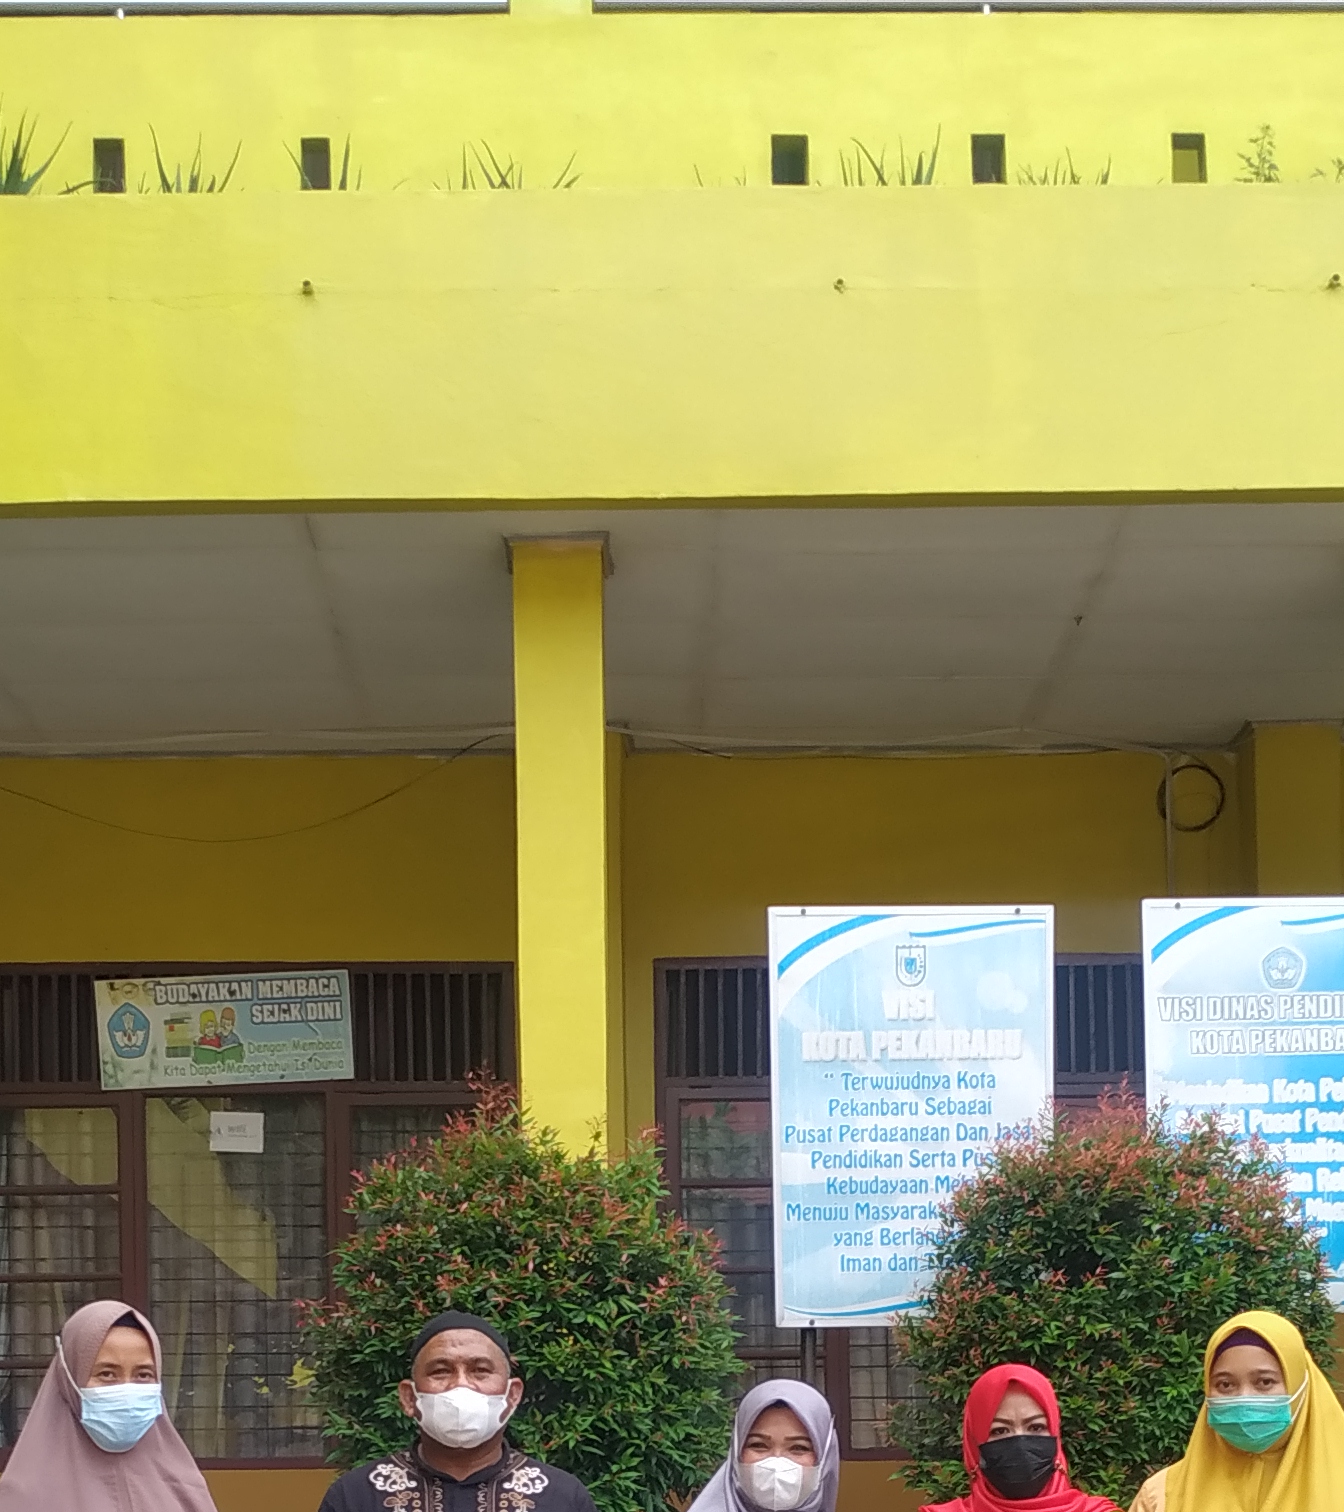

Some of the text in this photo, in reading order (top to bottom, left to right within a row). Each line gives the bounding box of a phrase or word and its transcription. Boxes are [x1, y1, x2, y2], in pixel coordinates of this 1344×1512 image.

[154, 980, 253, 1005] BUDAYAKAN
[256, 976, 341, 1000] MEMBACA
[250, 999, 343, 1025] SEJAK DINI
[881, 989, 935, 1022] VISI
[1157, 995, 1204, 1022] VISI
[1208, 994, 1275, 1021] DINAS
[247, 1038, 344, 1057] Dengan Membaca
[802, 1029, 1024, 1063] KOTA PEKANBARU
[1189, 1029, 1246, 1055] KOTA
[163, 1064, 186, 1077] Kita
[190, 1062, 223, 1078] Dapat
[313, 1056, 344, 1071] Dunia
[842, 1071, 951, 1093] Terwujudnya
[957, 1069, 996, 1090] Kota
[1273, 1078, 1315, 1103] Kota
[828, 1096, 993, 1118] Pekanbaru Sebagai
[784, 1123, 833, 1145] Pusat
[839, 1122, 950, 1145] Perdagangan
[955, 1122, 989, 1143] Dan
[810, 1149, 903, 1169] Pendidikan
[908, 1149, 957, 1169] Serta
[825, 1174, 930, 1197] Kebudayaan
[785, 1201, 849, 1222] Menuju
[832, 1228, 874, 1248] yang
[839, 1252, 882, 1273] Iman
[887, 1252, 918, 1273] dan
